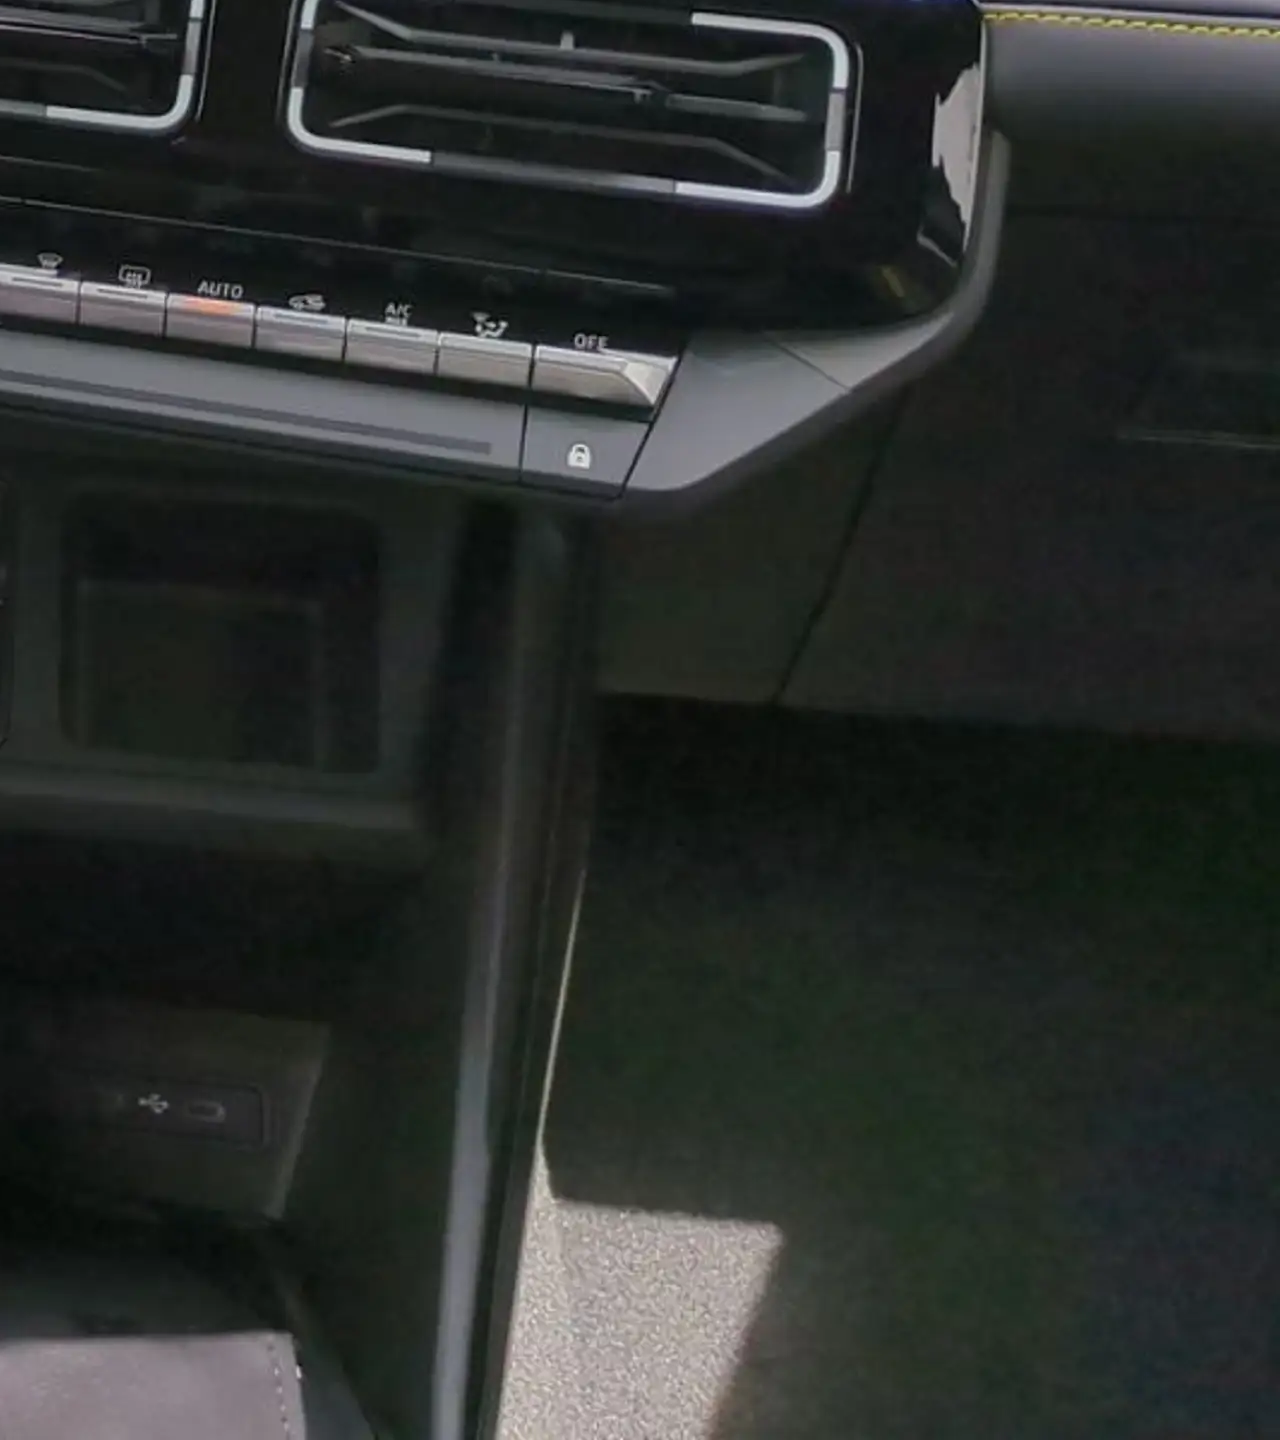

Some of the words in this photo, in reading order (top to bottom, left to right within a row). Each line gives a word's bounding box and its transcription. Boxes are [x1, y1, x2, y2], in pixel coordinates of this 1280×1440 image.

[198, 279, 243, 299] AUTO
[385, 302, 413, 319] A/C
[574, 333, 608, 351] OFF
